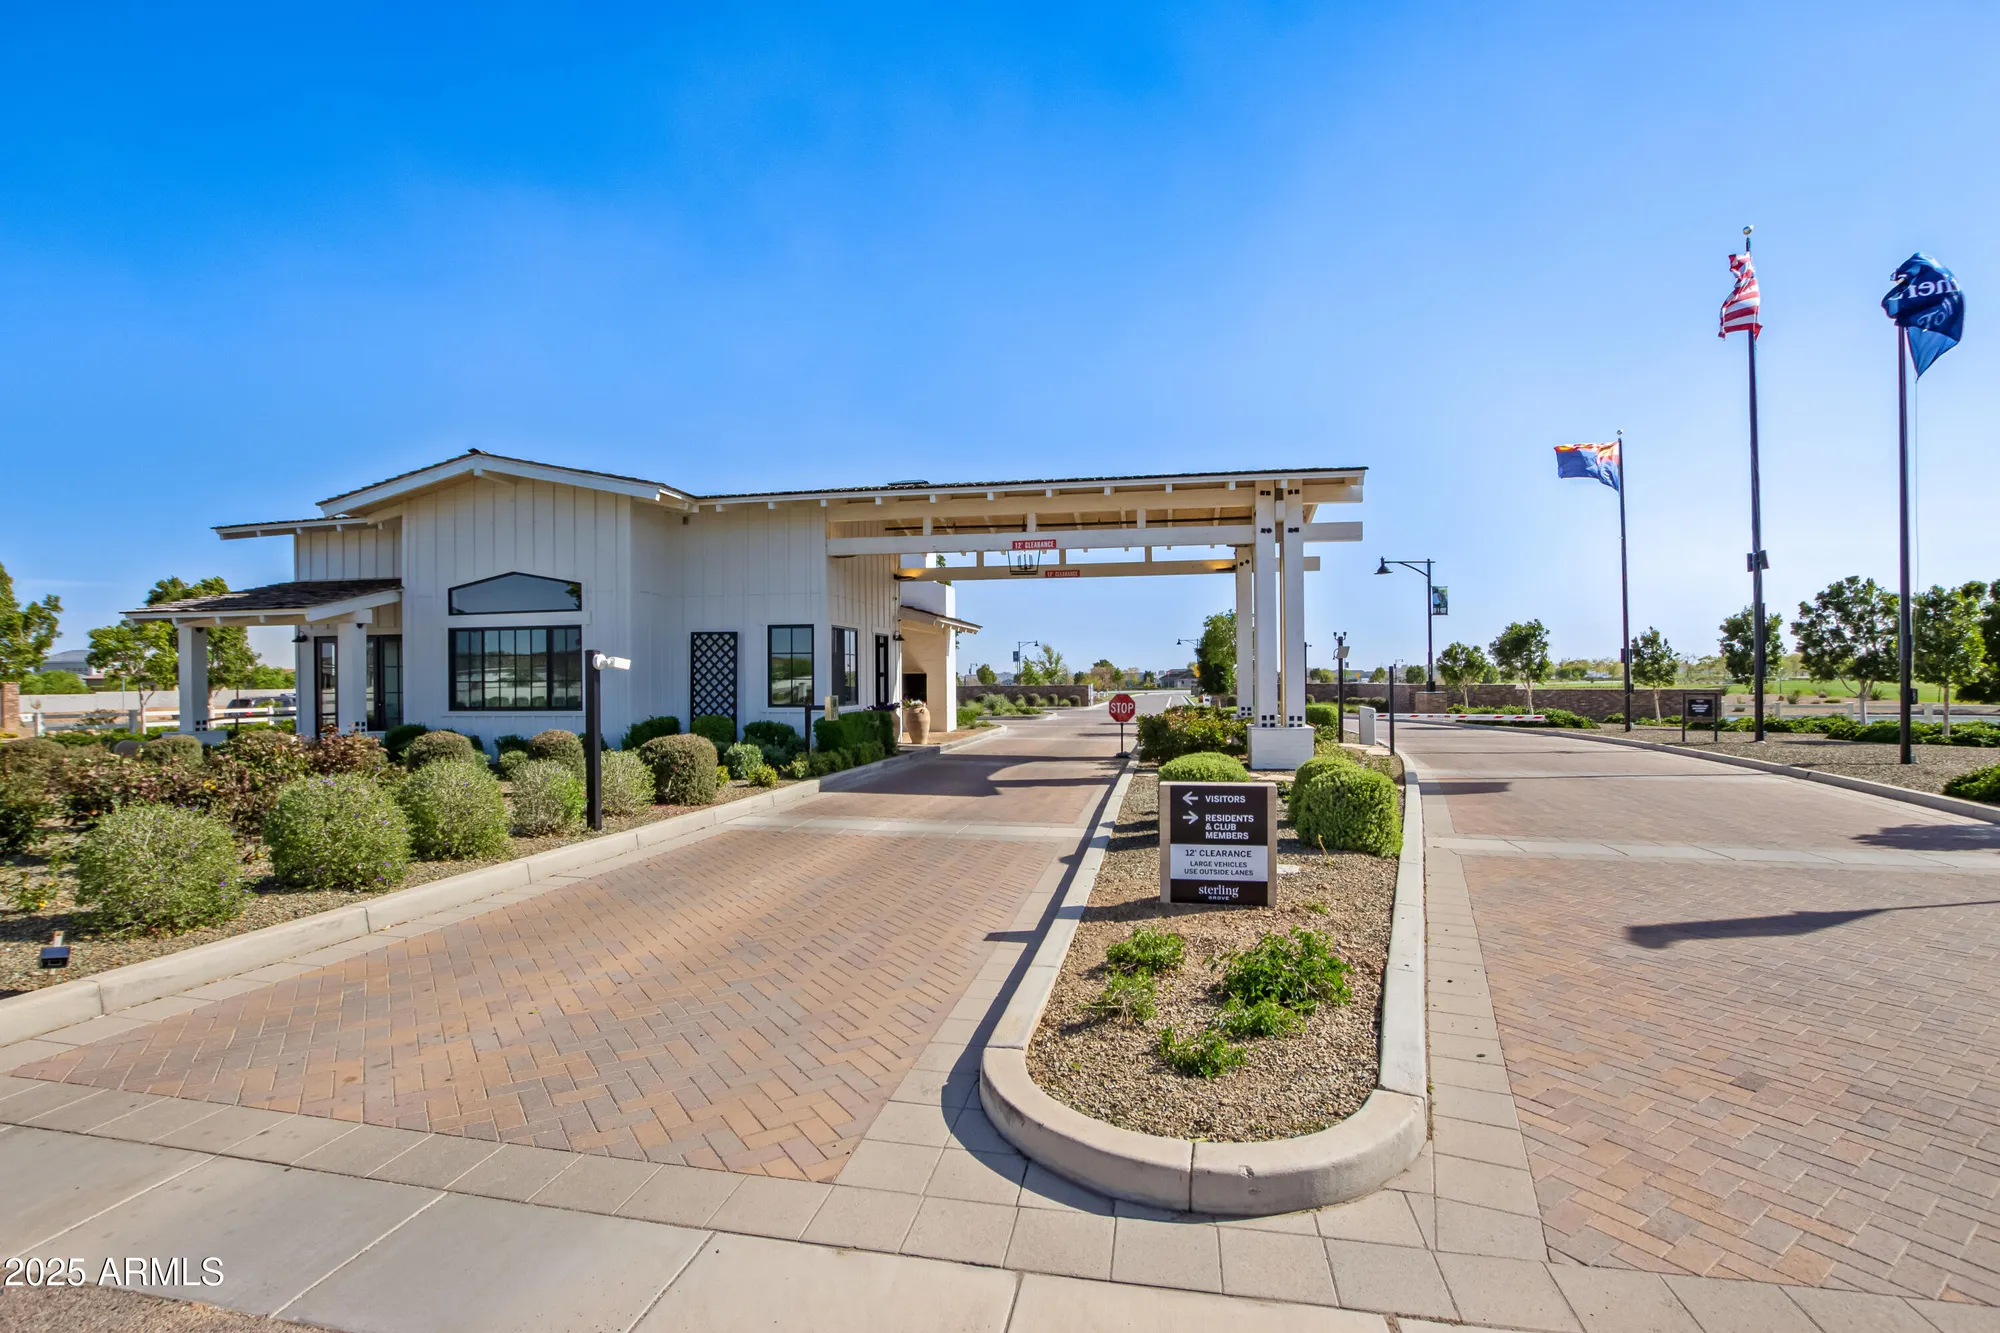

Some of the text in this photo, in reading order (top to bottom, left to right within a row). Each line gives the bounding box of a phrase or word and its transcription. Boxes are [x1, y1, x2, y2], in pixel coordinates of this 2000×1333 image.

[1024, 541, 1054, 549] CLEARANCE
[1110, 702, 1134, 714] STOP
[1205, 795, 1246, 803] VISITORS
[1205, 814, 1254, 822] RESIDENTS
[1205, 823, 1237, 831] & CLUB
[1205, 831, 1249, 840] MEMBERS
[1185, 849, 1252, 858] 12' CLEARANCE
[1198, 885, 1239, 898] sterling
